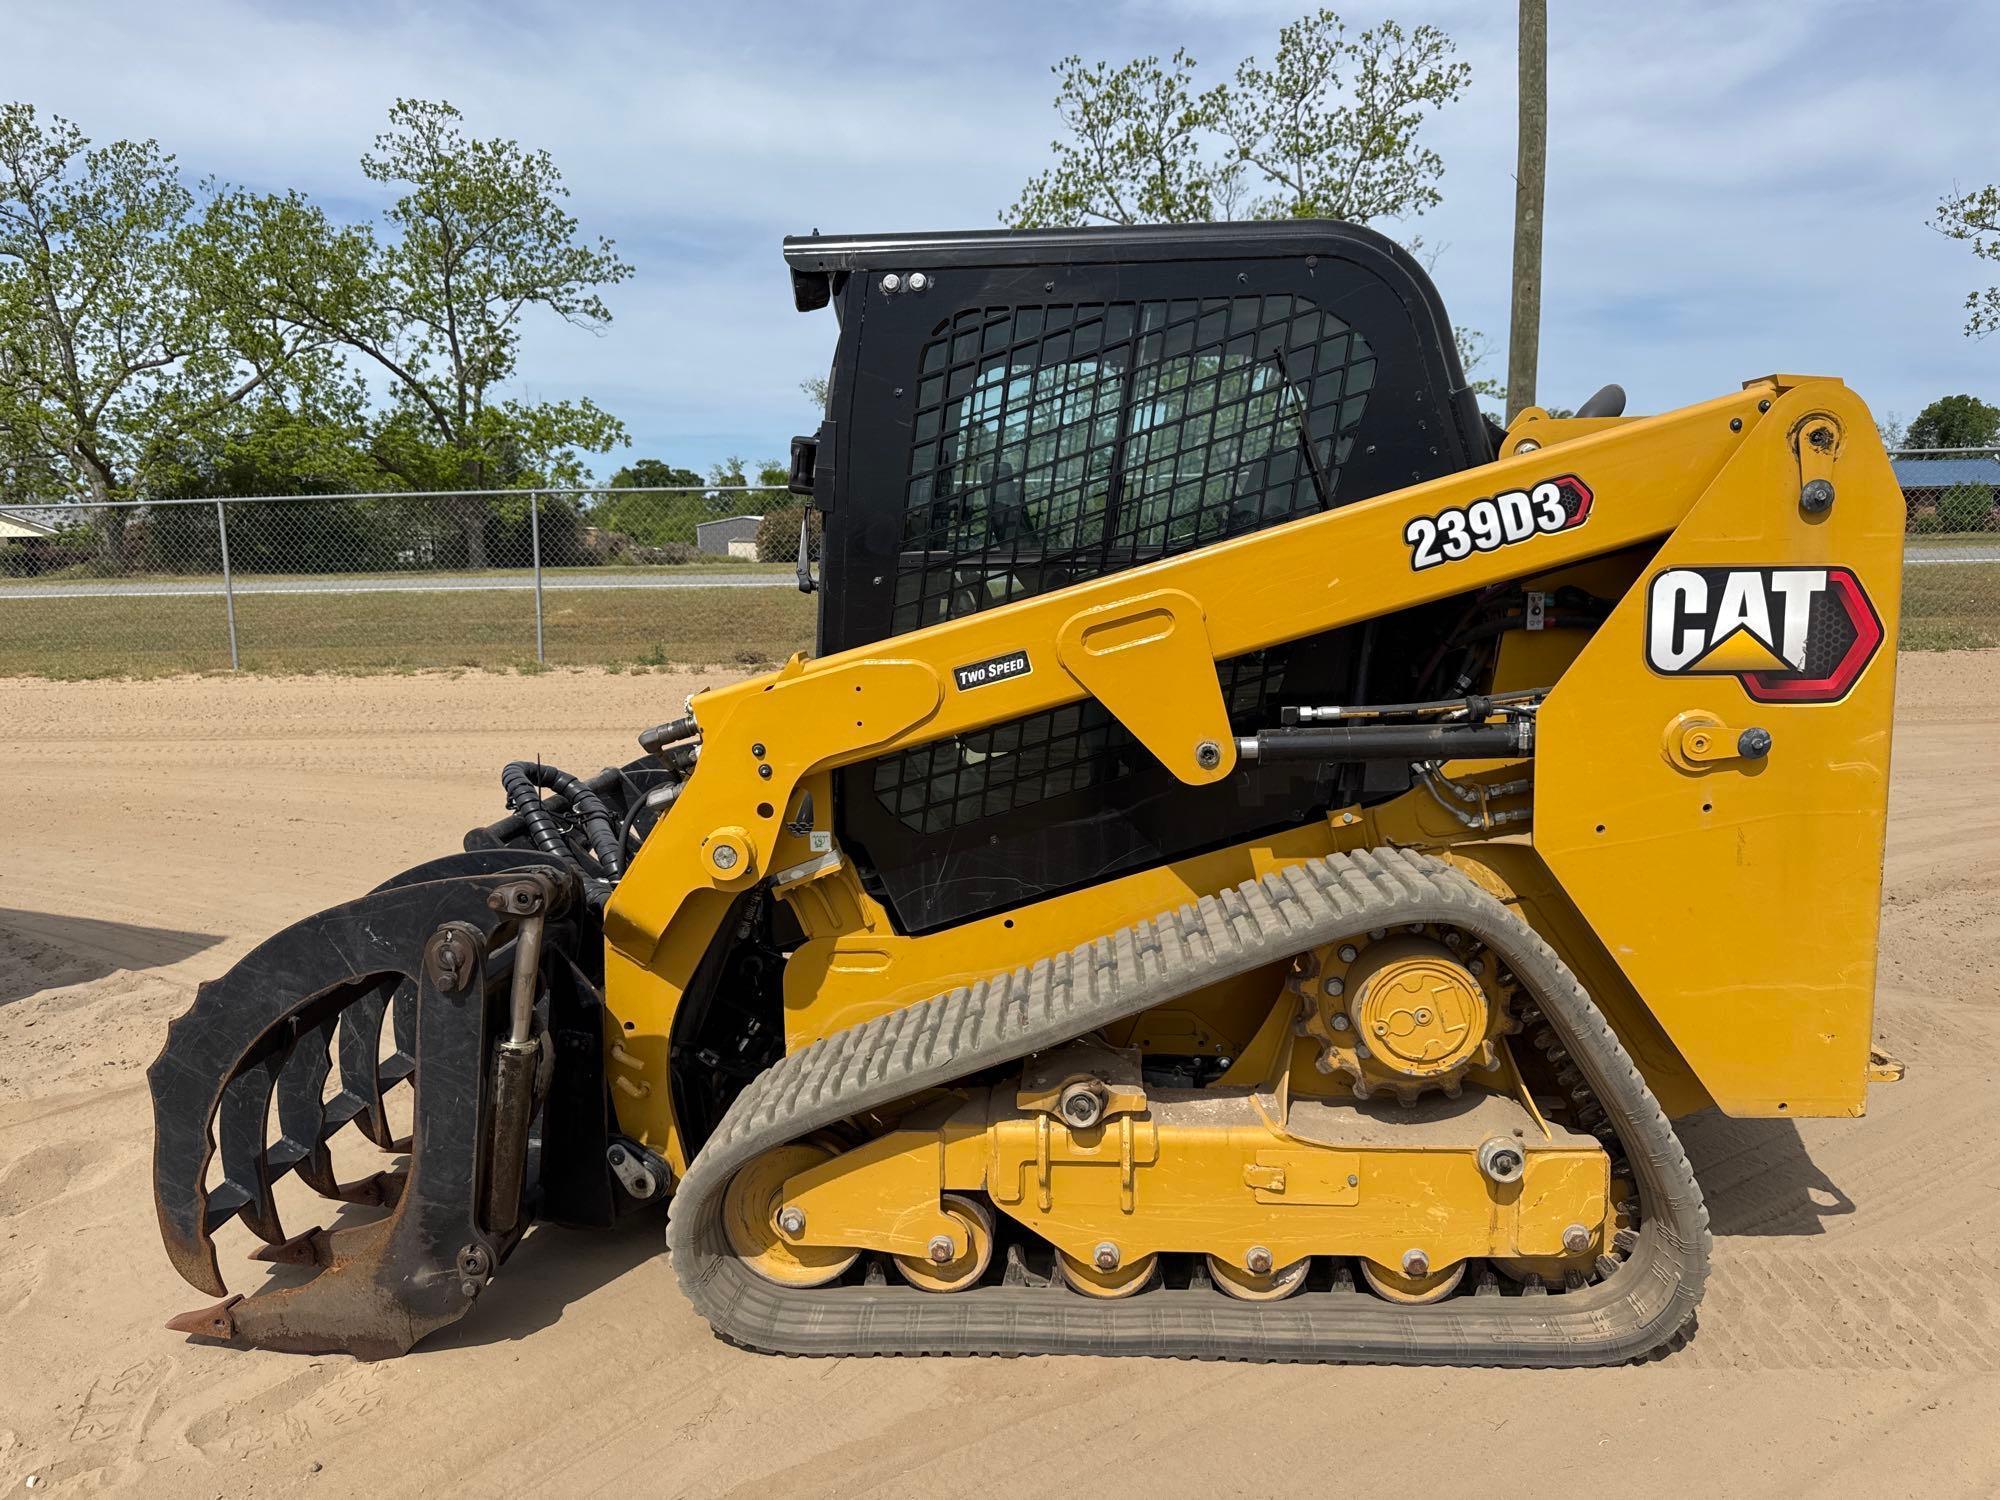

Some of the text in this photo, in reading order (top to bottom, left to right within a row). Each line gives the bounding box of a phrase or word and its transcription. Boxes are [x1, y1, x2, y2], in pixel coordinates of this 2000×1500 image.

[1406, 483, 1566, 569] 239D3
[1650, 570, 1827, 673] CAT
[959, 658, 1024, 685] TWO SPEED
